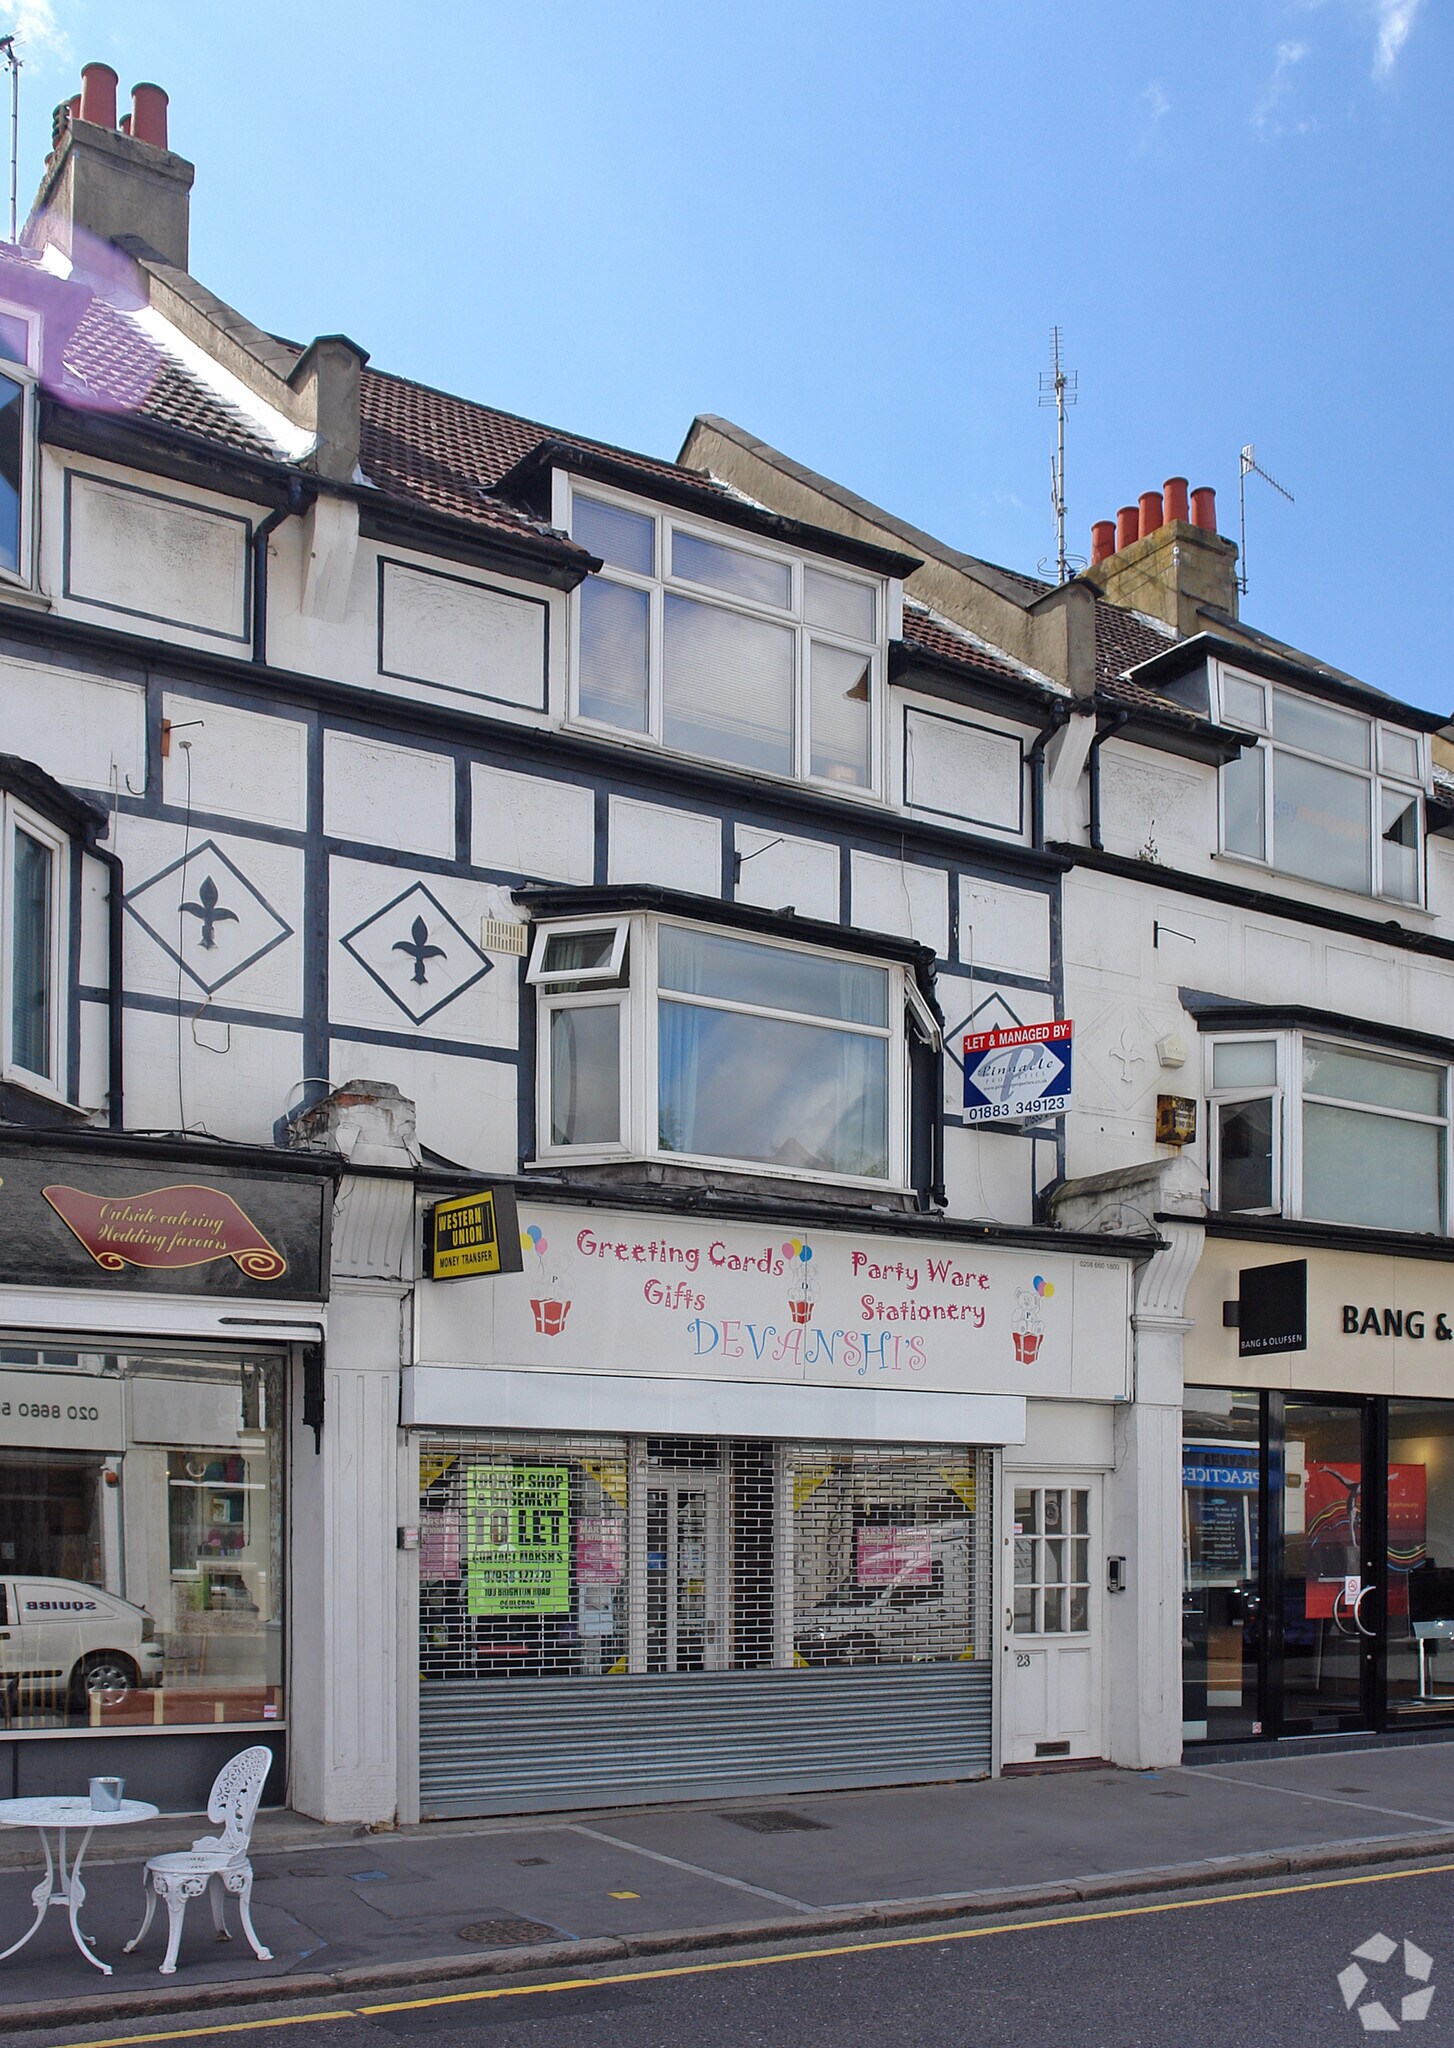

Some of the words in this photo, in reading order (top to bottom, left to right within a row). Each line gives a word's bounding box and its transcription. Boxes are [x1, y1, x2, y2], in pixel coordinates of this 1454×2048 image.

[966, 1036, 985, 1050] LET
[988, 1034, 996, 1047] &
[999, 1026, 1050, 1045] MANAGED
[982, 1058, 1054, 1077] Pinnacle
[985, 1071, 1045, 1084] PROERTIES
[969, 1103, 1010, 1120] 01883
[1015, 1097, 1065, 1114] 349123
[99, 1202, 157, 1224] Outside
[160, 1210, 225, 1236] catering
[438, 1206, 482, 1232] WESTERN
[98, 1224, 167, 1252] Wedding
[167, 1229, 227, 1253] favours
[452, 1224, 483, 1247] UNION
[440, 1255, 460, 1268] MONEY
[461, 1250, 493, 1264] TRANSFER
[576, 1229, 700, 1272] Greeting
[708, 1240, 784, 1276] Cards
[851, 1251, 919, 1291] Party
[926, 1258, 990, 1290] Ware
[643, 1279, 706, 1311] Gifts
[861, 1294, 986, 1329] Stationery
[1342, 1304, 1425, 1339] BANG
[1435, 1312, 1454, 1341] &
[687, 1318, 927, 1376] DEVANSHI'S
[1241, 1337, 1262, 1349] BANG
[1262, 1336, 1269, 1347] &
[1269, 1333, 1303, 1346] OLUFSEN
[528, 1474, 564, 1489] SHOP
[477, 1492, 487, 1506] &
[490, 1490, 560, 1507] BASEMENT
[471, 1508, 508, 1545] TO
[518, 1509, 564, 1546] LET
[472, 1550, 517, 1564] CONTACT
[497, 1588, 531, 1597] BRIGHTON
[532, 1588, 551, 1597] ROAD
[1016, 1654, 1030, 1667] 23
